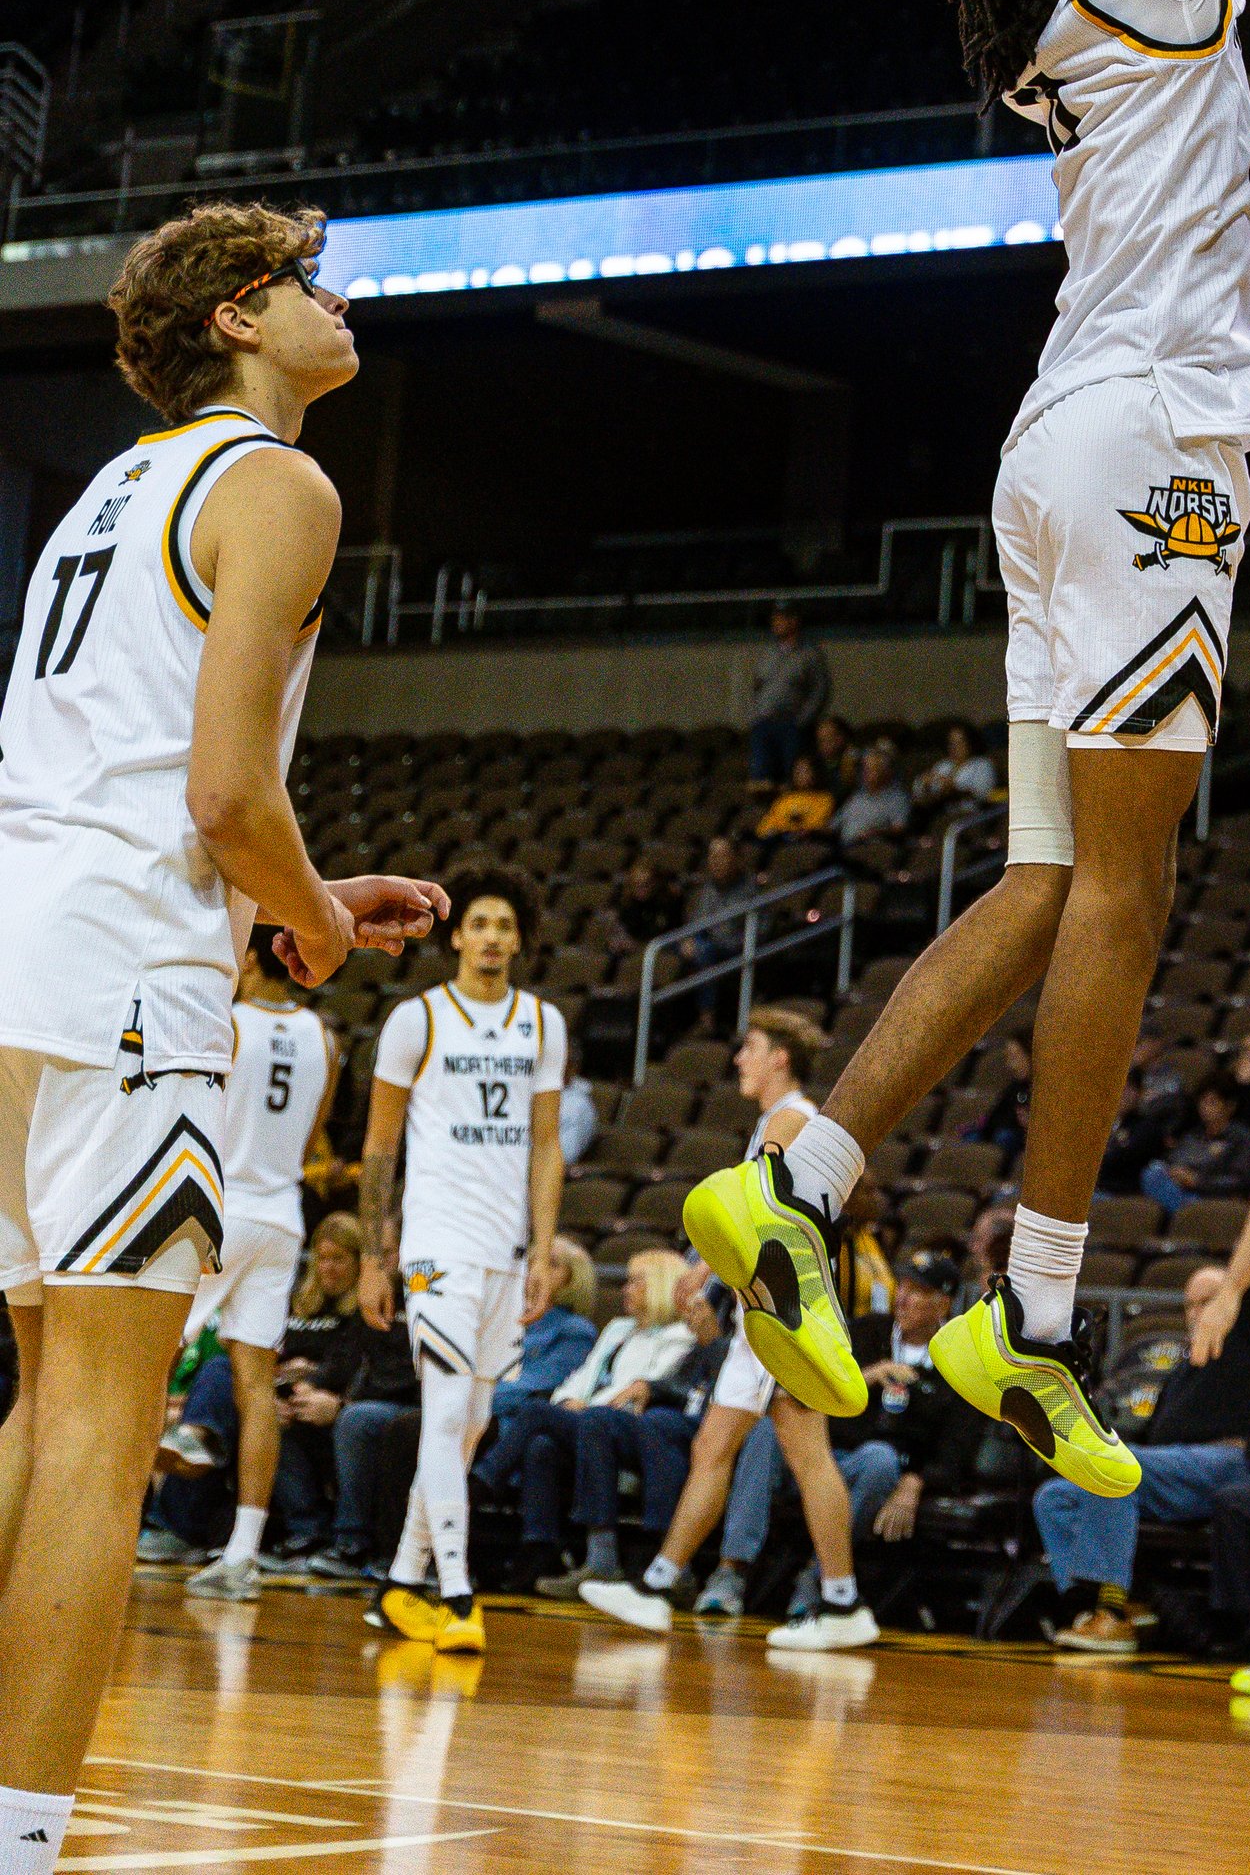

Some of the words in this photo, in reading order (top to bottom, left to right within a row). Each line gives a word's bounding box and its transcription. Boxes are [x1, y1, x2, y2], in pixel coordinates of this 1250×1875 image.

[1172, 478, 1213, 494] NKU
[87, 493, 132, 536] RUIZ
[1148, 489, 1230, 525] NORSE
[35, 543, 118, 680] 17
[443, 1054, 535, 1077] NORTHERN
[266, 1063, 293, 1113] 5
[478, 1081, 508, 1119] 12
